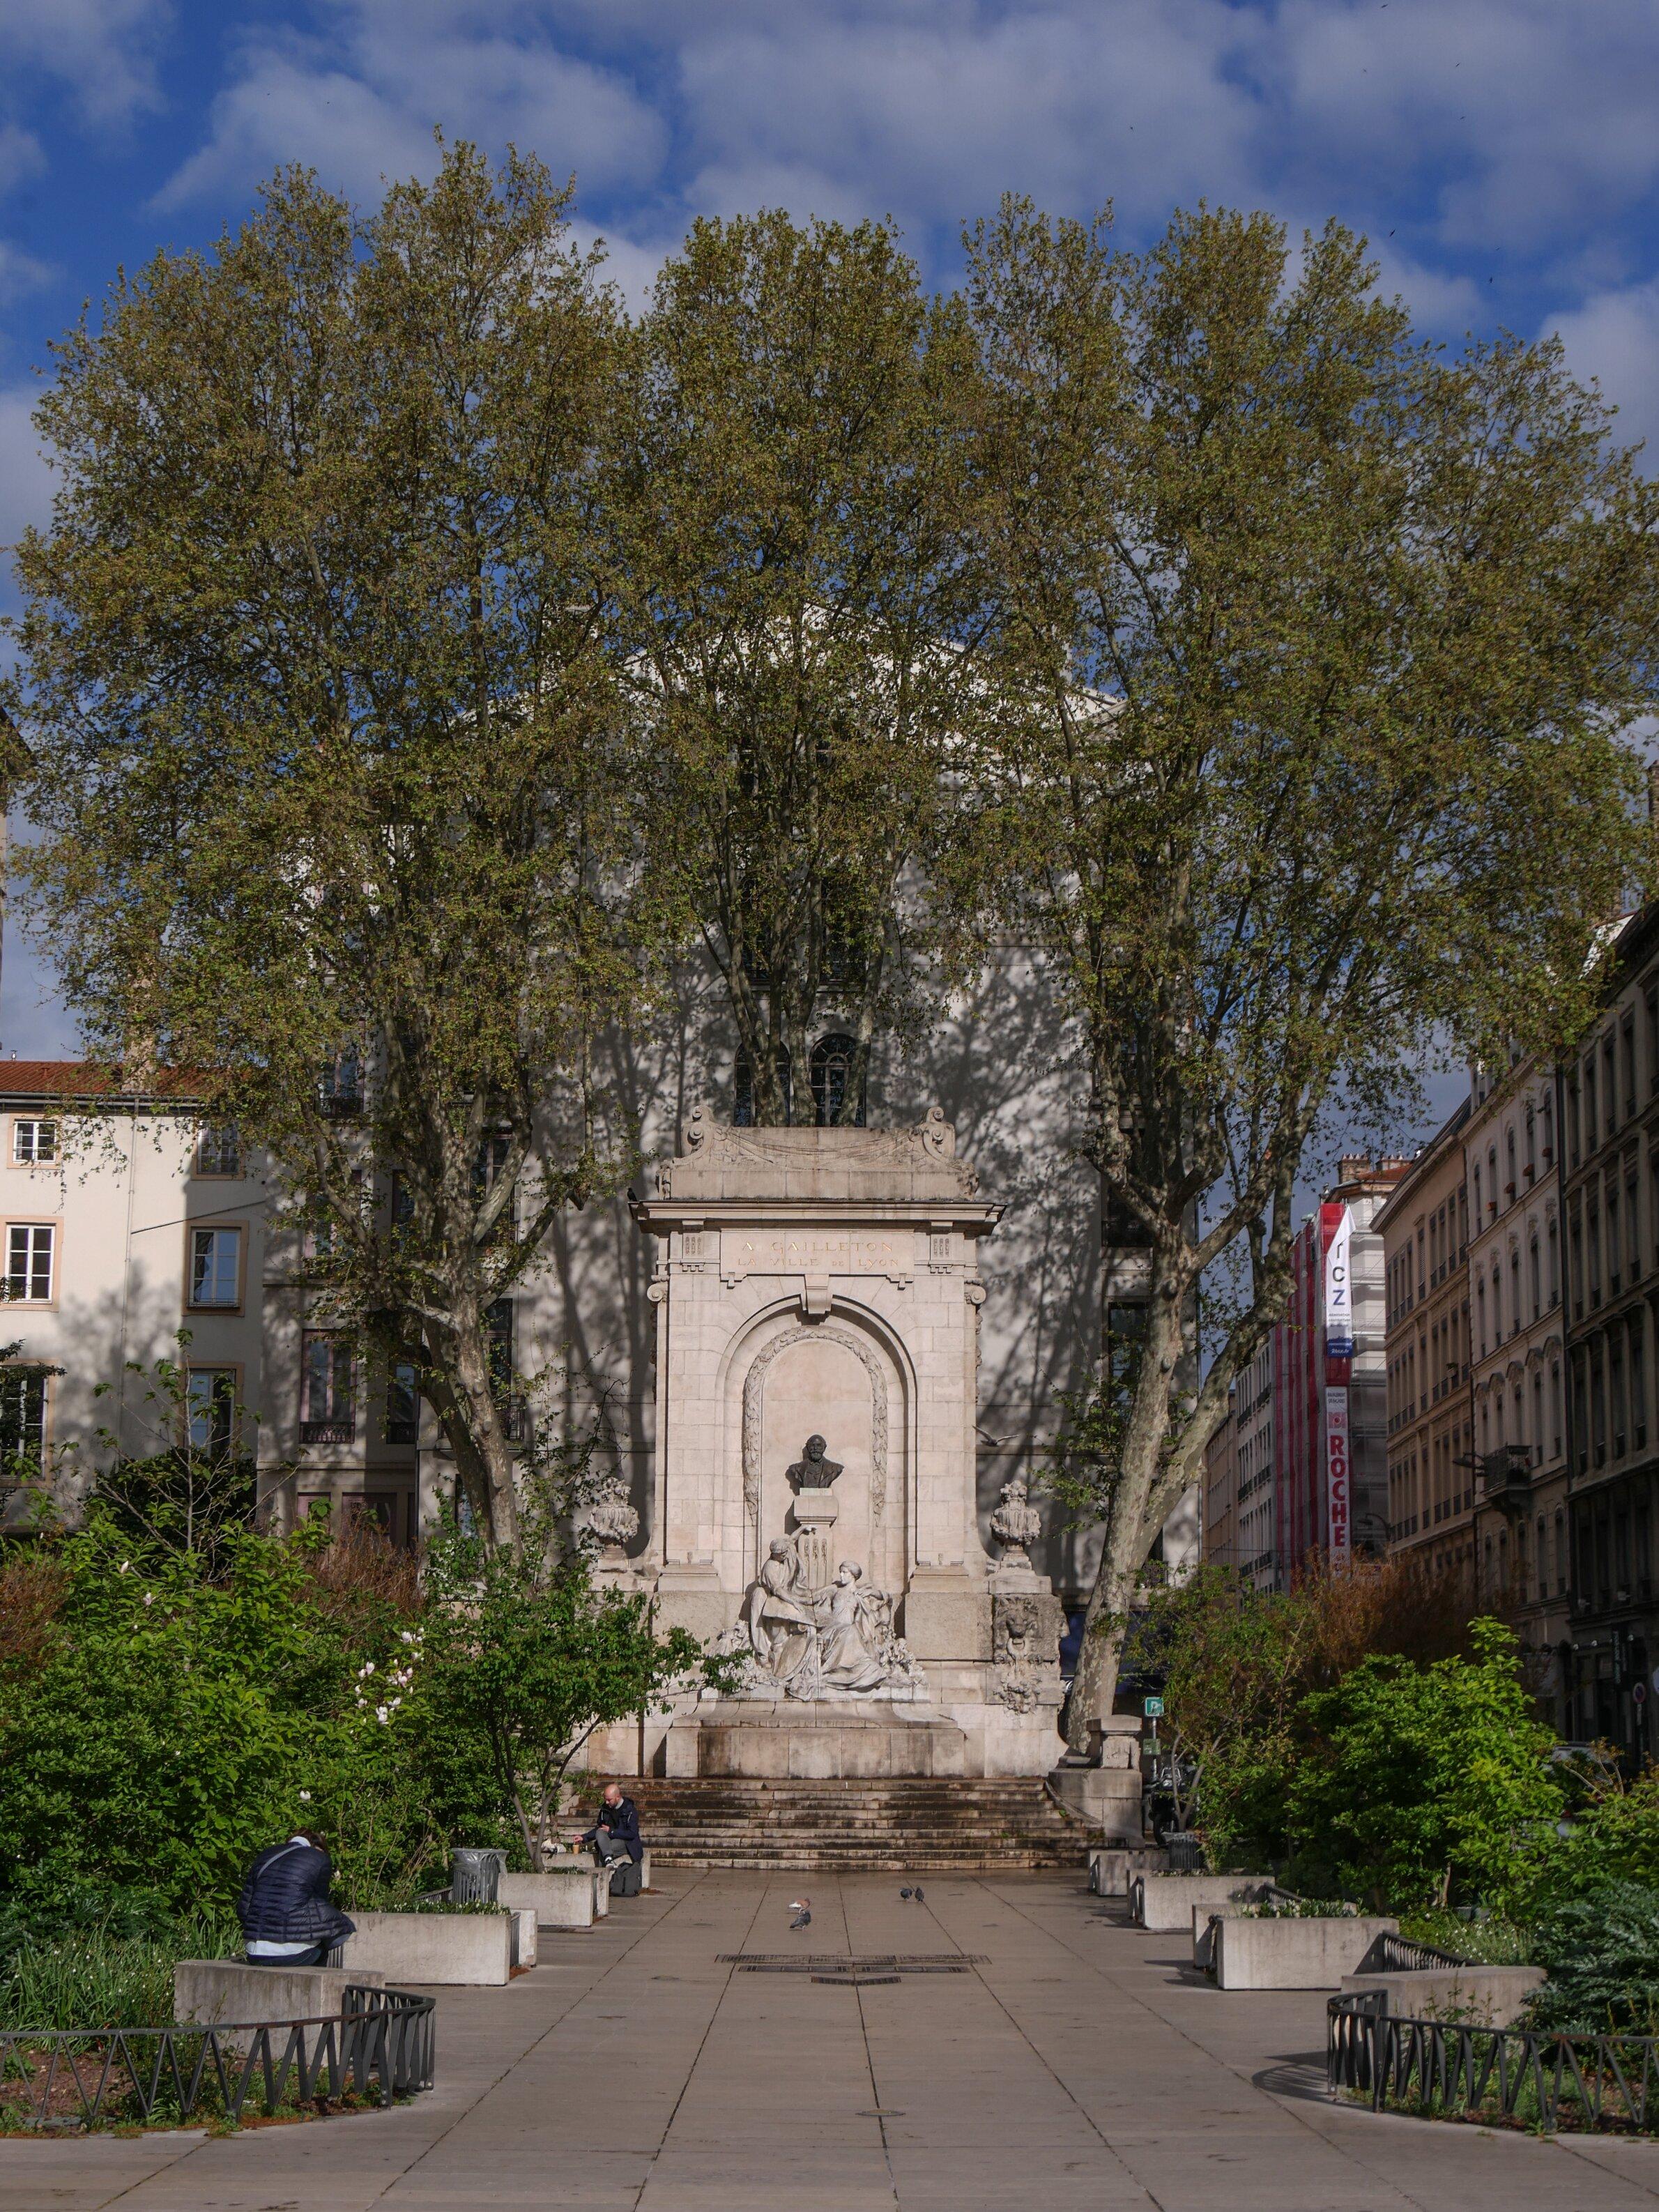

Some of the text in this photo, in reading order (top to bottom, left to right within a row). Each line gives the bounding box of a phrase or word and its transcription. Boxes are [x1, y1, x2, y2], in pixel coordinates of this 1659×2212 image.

[742, 1242, 893, 1253] A GAILLETON
[1330, 1435, 1347, 1547] ROCHE
